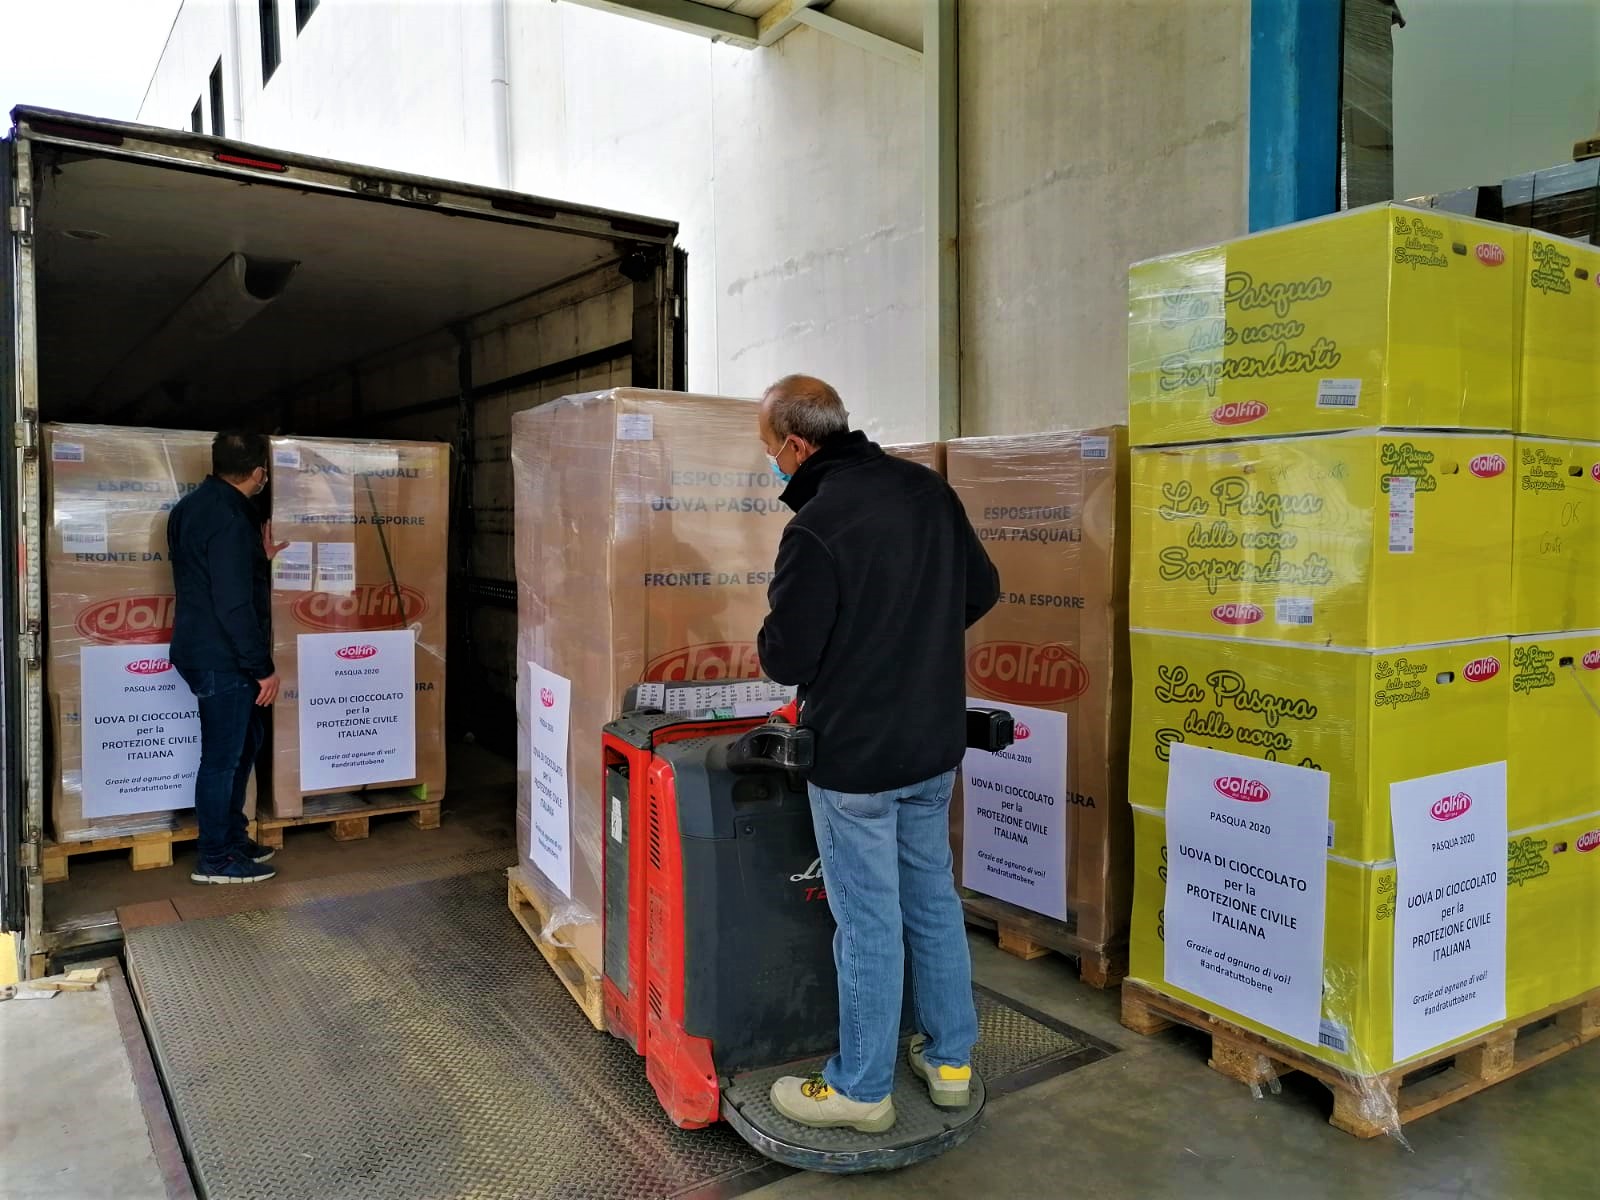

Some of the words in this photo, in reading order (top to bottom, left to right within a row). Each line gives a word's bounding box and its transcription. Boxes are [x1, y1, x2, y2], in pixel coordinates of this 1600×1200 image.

[1477, 243, 1504, 260] dolfin
[1160, 286, 1209, 329] La
[1212, 271, 1332, 318] Pasqua
[1189, 320, 1238, 353] dalle
[1242, 320, 1305, 344] uova
[1160, 337, 1341, 397] Sorprendenti
[1214, 401, 1262, 419] dolfin
[1472, 454, 1504, 472] dolfin
[671, 472, 784, 488] ESPOSITOR
[714, 498, 792, 516] PASQU
[1160, 480, 1210, 520] La
[1210, 476, 1324, 529] Pasqua
[352, 515, 368, 525] DA
[371, 514, 424, 526] ESPORRE
[984, 506, 1071, 520] ESPOSITORE
[1012, 528, 1082, 544] PASQUALI
[1188, 521, 1238, 548] dalle
[1241, 532, 1297, 550] uova
[76, 552, 137, 562] FRONTE
[142, 552, 162, 562] DA
[644, 572, 711, 586] FRONTE
[718, 572, 740, 585] DA
[746, 571, 774, 585] ESP
[1160, 546, 1333, 596] Sorprendenti
[310, 587, 411, 617] dolfin
[1009, 593, 1026, 605] DA
[1030, 594, 1085, 608] ESPORRE
[1215, 604, 1258, 620] dolfin
[340, 646, 374, 656] dolfin
[130, 658, 171, 671] dolfin
[364, 668, 380, 676] 2020
[662, 646, 760, 682] dolf
[974, 645, 1073, 689] dolfin
[1466, 657, 1496, 677] dolfin
[124, 684, 156, 693] PASQUA
[158, 684, 176, 692] 2020
[414, 682, 434, 693] URA
[1155, 665, 1205, 703] La
[1206, 670, 1318, 728] Pasqua
[310, 698, 336, 706] UOVA
[338, 696, 348, 704] DI
[350, 692, 404, 704] CIOCCOLATO
[94, 716, 126, 725] UOVA
[128, 714, 139, 722] DI
[346, 707, 360, 716] per
[362, 706, 370, 714] la
[136, 725, 154, 736] per
[156, 724, 165, 734] la
[316, 718, 371, 729] PROTEZIONE
[372, 716, 398, 724] CIVILE
[1184, 709, 1233, 738] dalle
[1236, 727, 1292, 750] uova
[102, 738, 166, 750] PROTEZIONE
[168, 736, 198, 745] CIVILE
[338, 728, 378, 739] ITALIANA
[128, 750, 174, 760] ITALIANA
[992, 751, 1016, 762] PASQUA
[1016, 754, 1032, 764] 2020
[105, 777, 130, 786] Grazie
[142, 774, 172, 784] ognuno
[174, 772, 180, 780] di
[119, 782, 182, 794] #andratuttobene
[1220, 776, 1264, 798] dolfin
[972, 776, 994, 791] UOVA
[995, 782, 1004, 793] DI
[1004, 784, 1054, 806] CIOCCOLATO
[1001, 800, 1014, 812] per
[1016, 803, 1023, 813] la
[1434, 793, 1468, 815] dolfin
[976, 808, 1023, 828] PROTEZIONE
[1024, 817, 1048, 836] CIVILE
[1210, 812, 1246, 828] PASQUA
[1249, 821, 1271, 835] 2020
[994, 826, 1028, 846] ITALIANA
[1432, 838, 1458, 853] PASQUA
[1460, 832, 1476, 846] 2020
[978, 850, 996, 864] Grazie
[1004, 860, 1026, 873] ognuno
[1028, 864, 1034, 873] di
[1180, 844, 1211, 864] UOVA
[1214, 855, 1226, 868] DI
[1230, 860, 1306, 892] CIOCCOLATO
[1224, 879, 1243, 892] per
[1246, 882, 1256, 896] la
[1407, 890, 1434, 909] UOVA
[1436, 886, 1444, 901] DI
[1446, 871, 1497, 899] CIOCCOLATO
[1186, 884, 1257, 916] PROTEZIONE
[1260, 908, 1297, 930] CIVILE
[1441, 906, 1455, 922] per
[1456, 902, 1464, 914] la
[1212, 911, 1266, 940] ITALIANA
[1412, 920, 1465, 948] PROTEZIONE
[1466, 912, 1491, 931] CIVILE
[1432, 940, 1471, 962] ITALIANA
[1186, 940, 1212, 956] Grazie
[1214, 948, 1226, 960] ad
[1227, 954, 1260, 974] ognuno
[1262, 964, 1272, 976] di
[1273, 970, 1292, 986] voi!
[1200, 958, 1273, 994] #andratuttobene
[1412, 988, 1434, 1005] Grazie
[1434, 986, 1444, 998] ad
[1444, 979, 1468, 996] ognuno
[1468, 974, 1476, 986] di
[1476, 970, 1488, 984] voi!
[1424, 992, 1476, 1017] #andratuttobene
